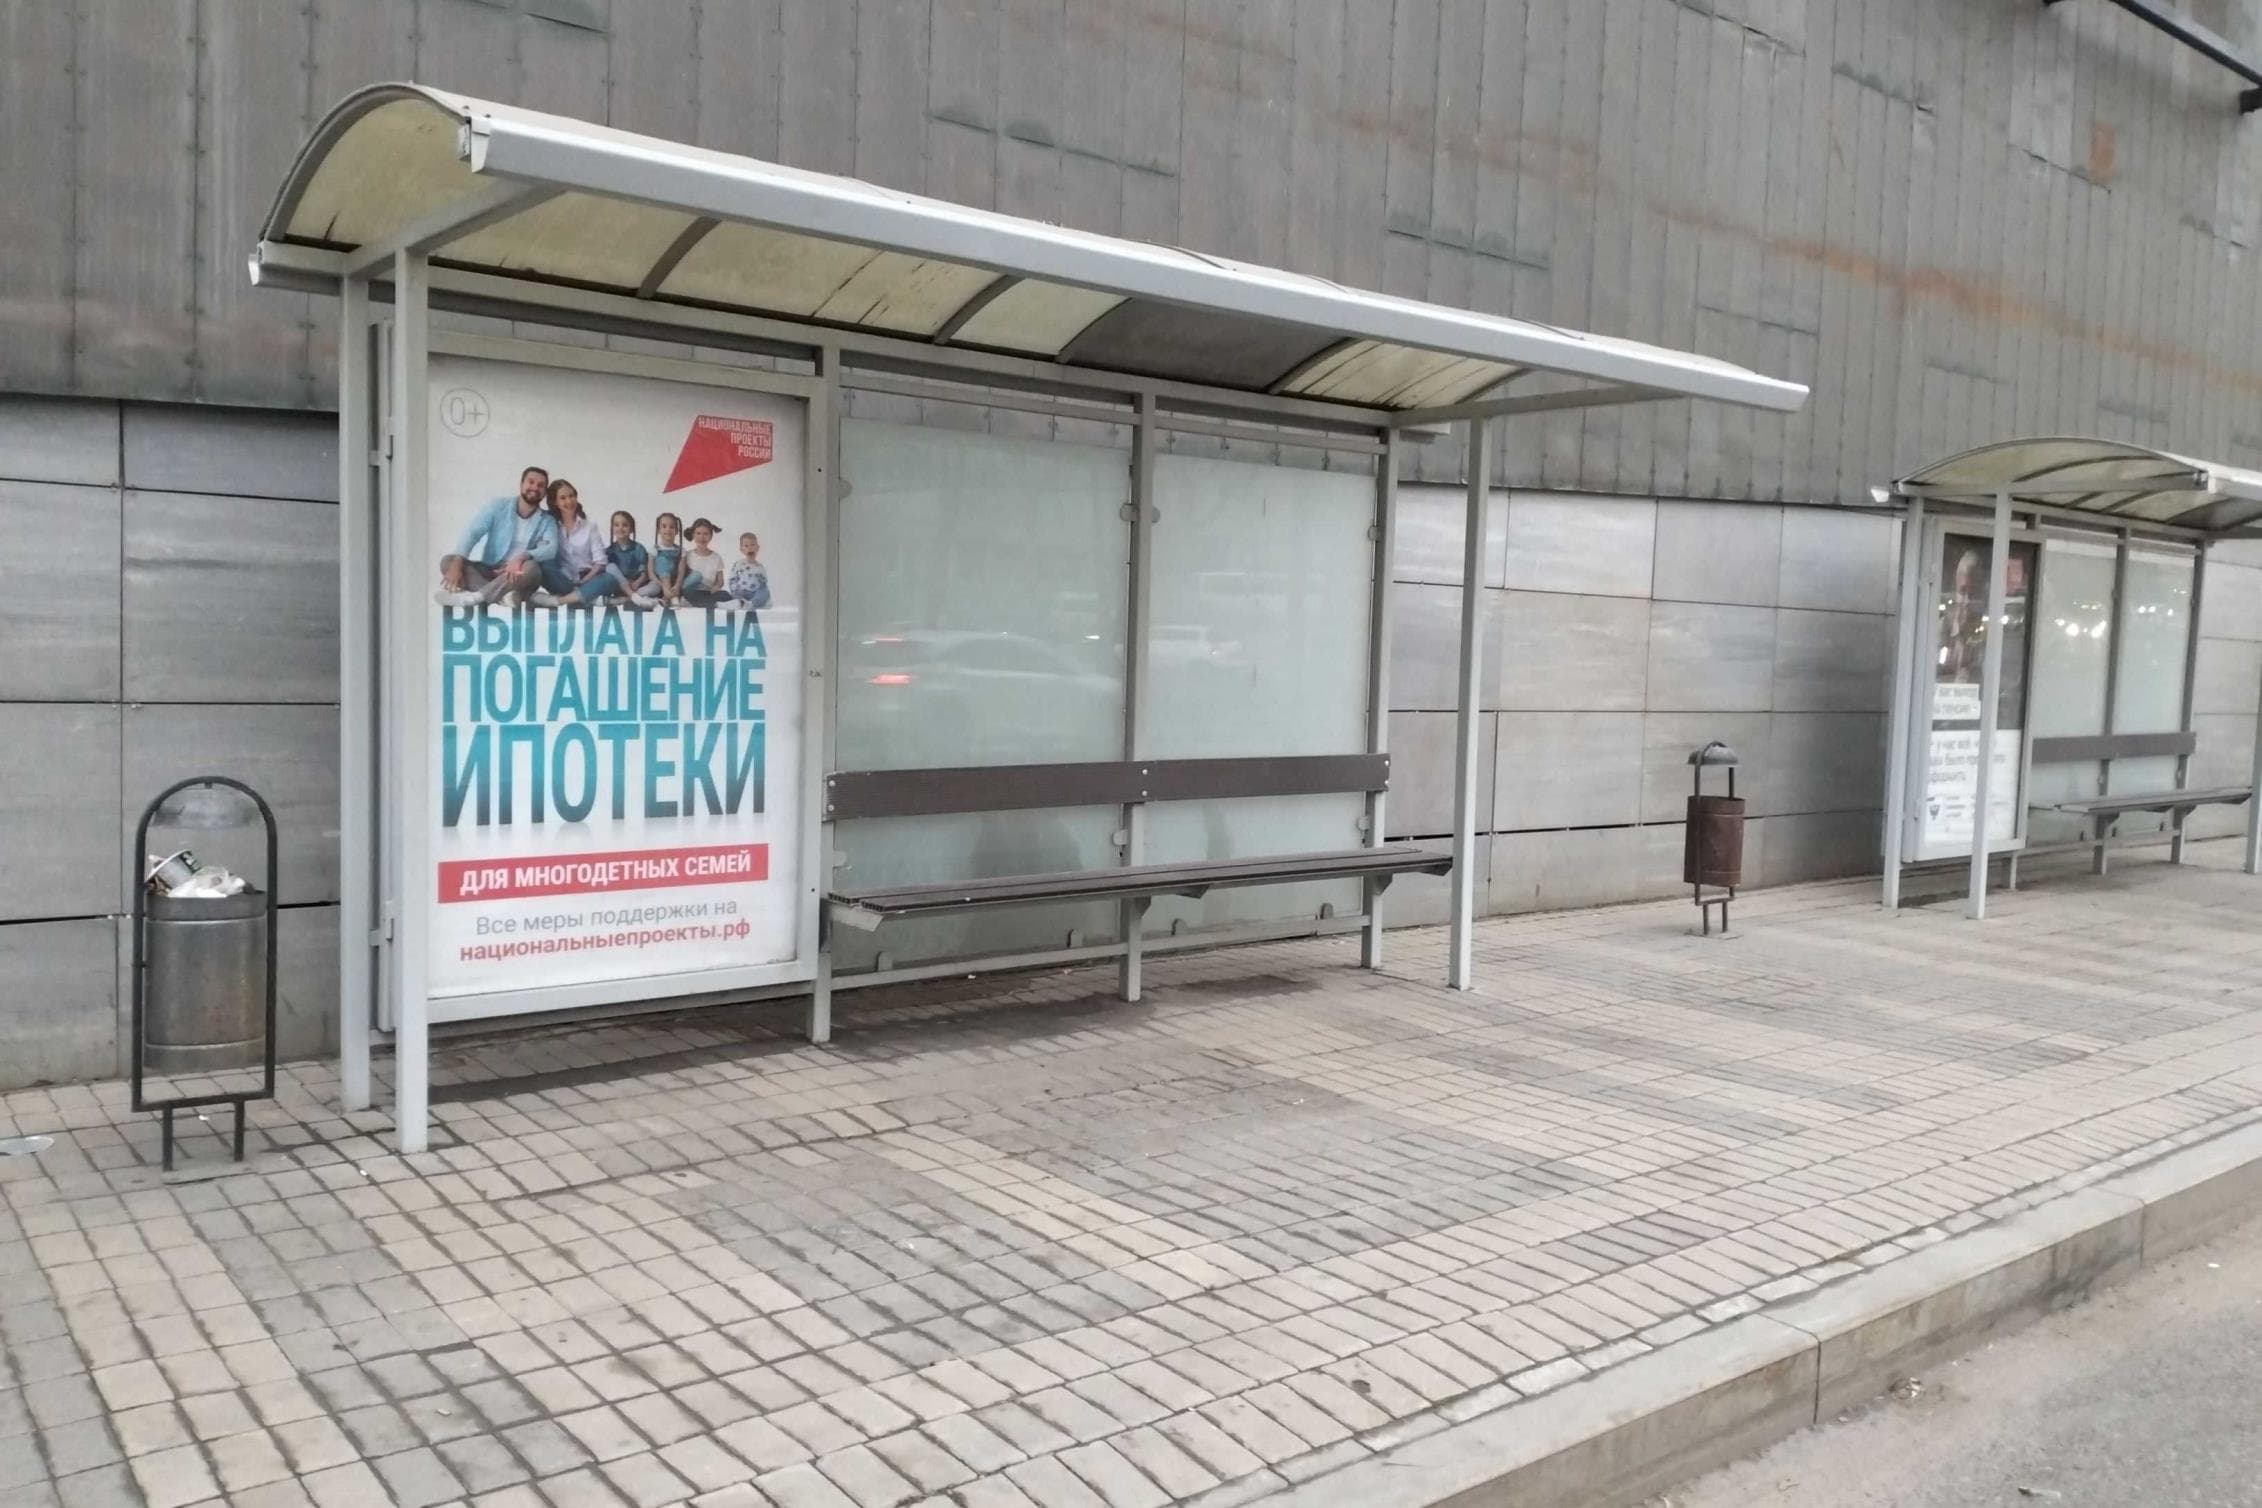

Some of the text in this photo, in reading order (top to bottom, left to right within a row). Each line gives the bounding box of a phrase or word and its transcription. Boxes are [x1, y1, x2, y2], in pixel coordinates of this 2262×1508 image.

[699, 416, 771, 435] НАЦИОНАЛЬНЫЕ
[731, 431, 771, 447] ПРОЕКТЫ
[738, 445, 771, 458] РОССИИ
[443, 601, 767, 657] ВЫПЛАТА НА
[442, 655, 765, 722] ПОГАШЕНИЕ
[442, 722, 766, 828] ИПОТЕКИ
[459, 849, 752, 895] ДЛЯ МНОГОДЕТНЫХ СЕМЕЙ
[476, 900, 738, 935] Все меры поддержки на
[460, 919, 751, 960] национальныепроекты.рф
